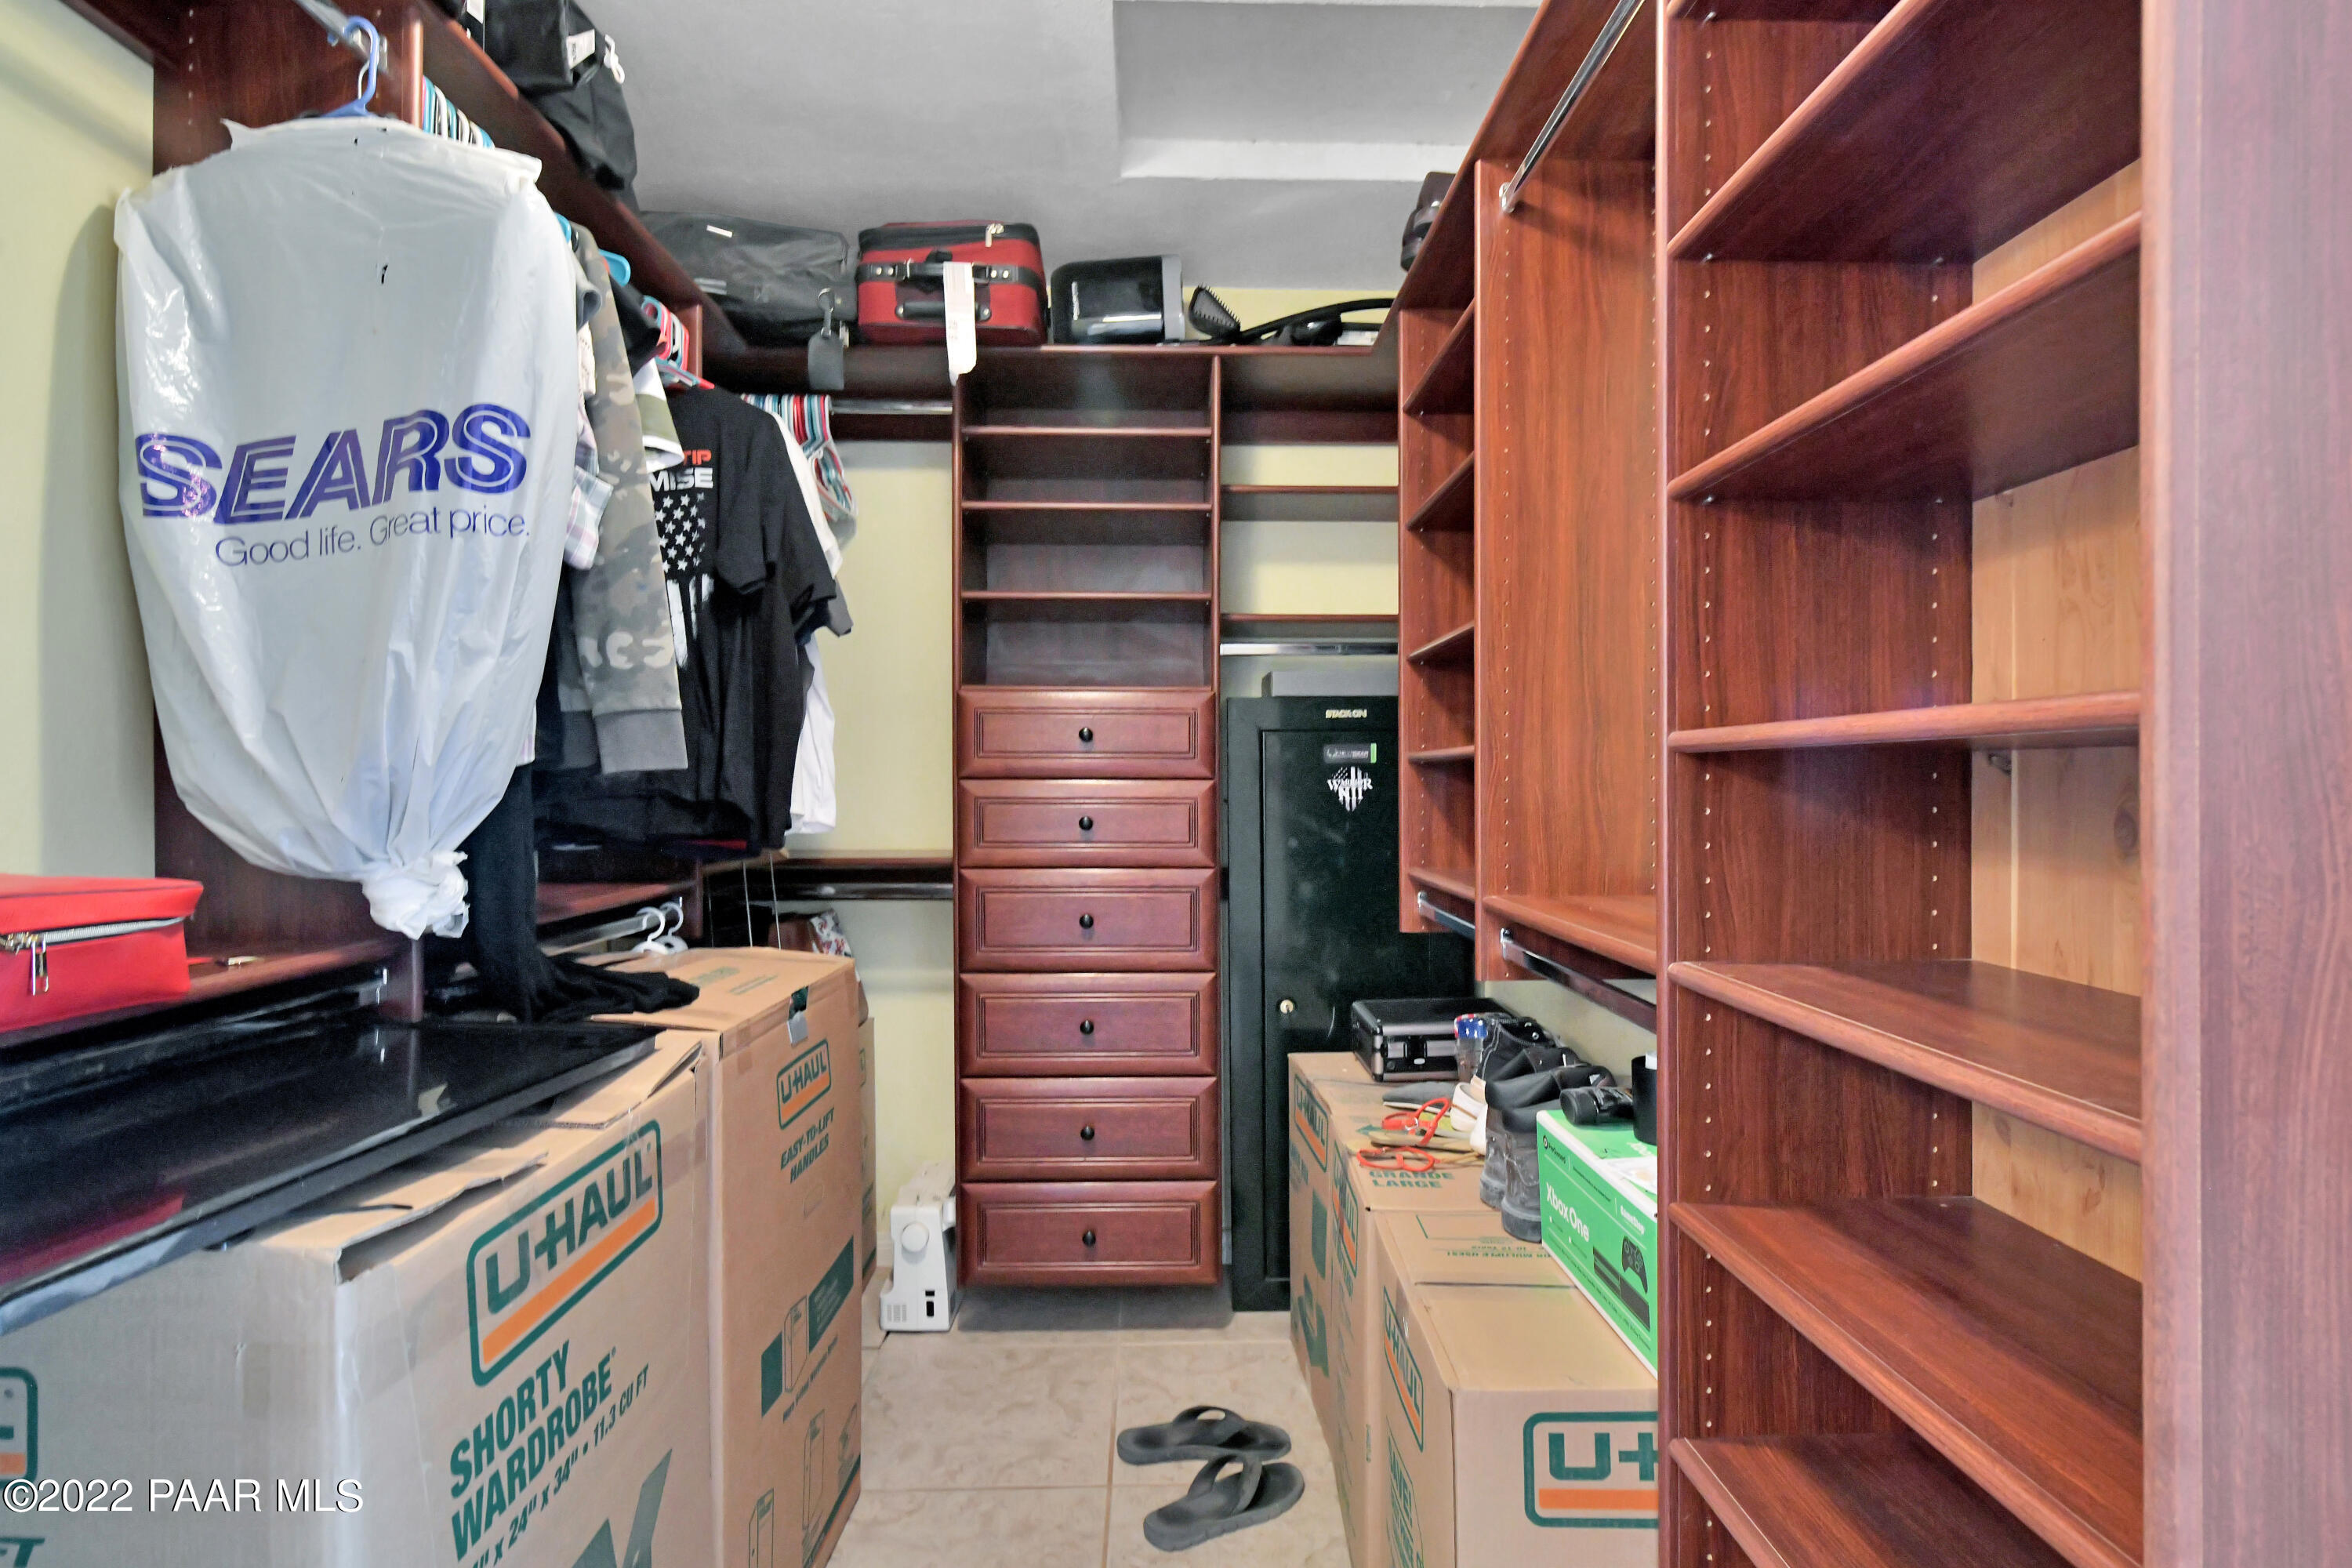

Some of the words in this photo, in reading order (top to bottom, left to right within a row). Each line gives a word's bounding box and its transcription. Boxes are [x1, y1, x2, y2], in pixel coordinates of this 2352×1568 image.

[135, 403, 531, 525] SEARS
[215, 532, 309, 567] Good
[318, 526, 361, 556] life.
[370, 507, 441, 546] Great
[449, 504, 530, 538] price.
[780, 1051, 828, 1105] U-HAUL
[790, 1133, 829, 1184] HANDLES
[1369, 1171, 1455, 1180] GRANDE
[1373, 1179, 1443, 1188] LARGE
[485, 1148, 654, 1316] U-HAUL
[1385, 1299, 1421, 1417] U-HAUL
[450, 1338, 570, 1499] SHORTY
[593, 1403, 616, 1447] 11.3
[619, 1381, 634, 1417] CU
[636, 1362, 649, 1398] FT
